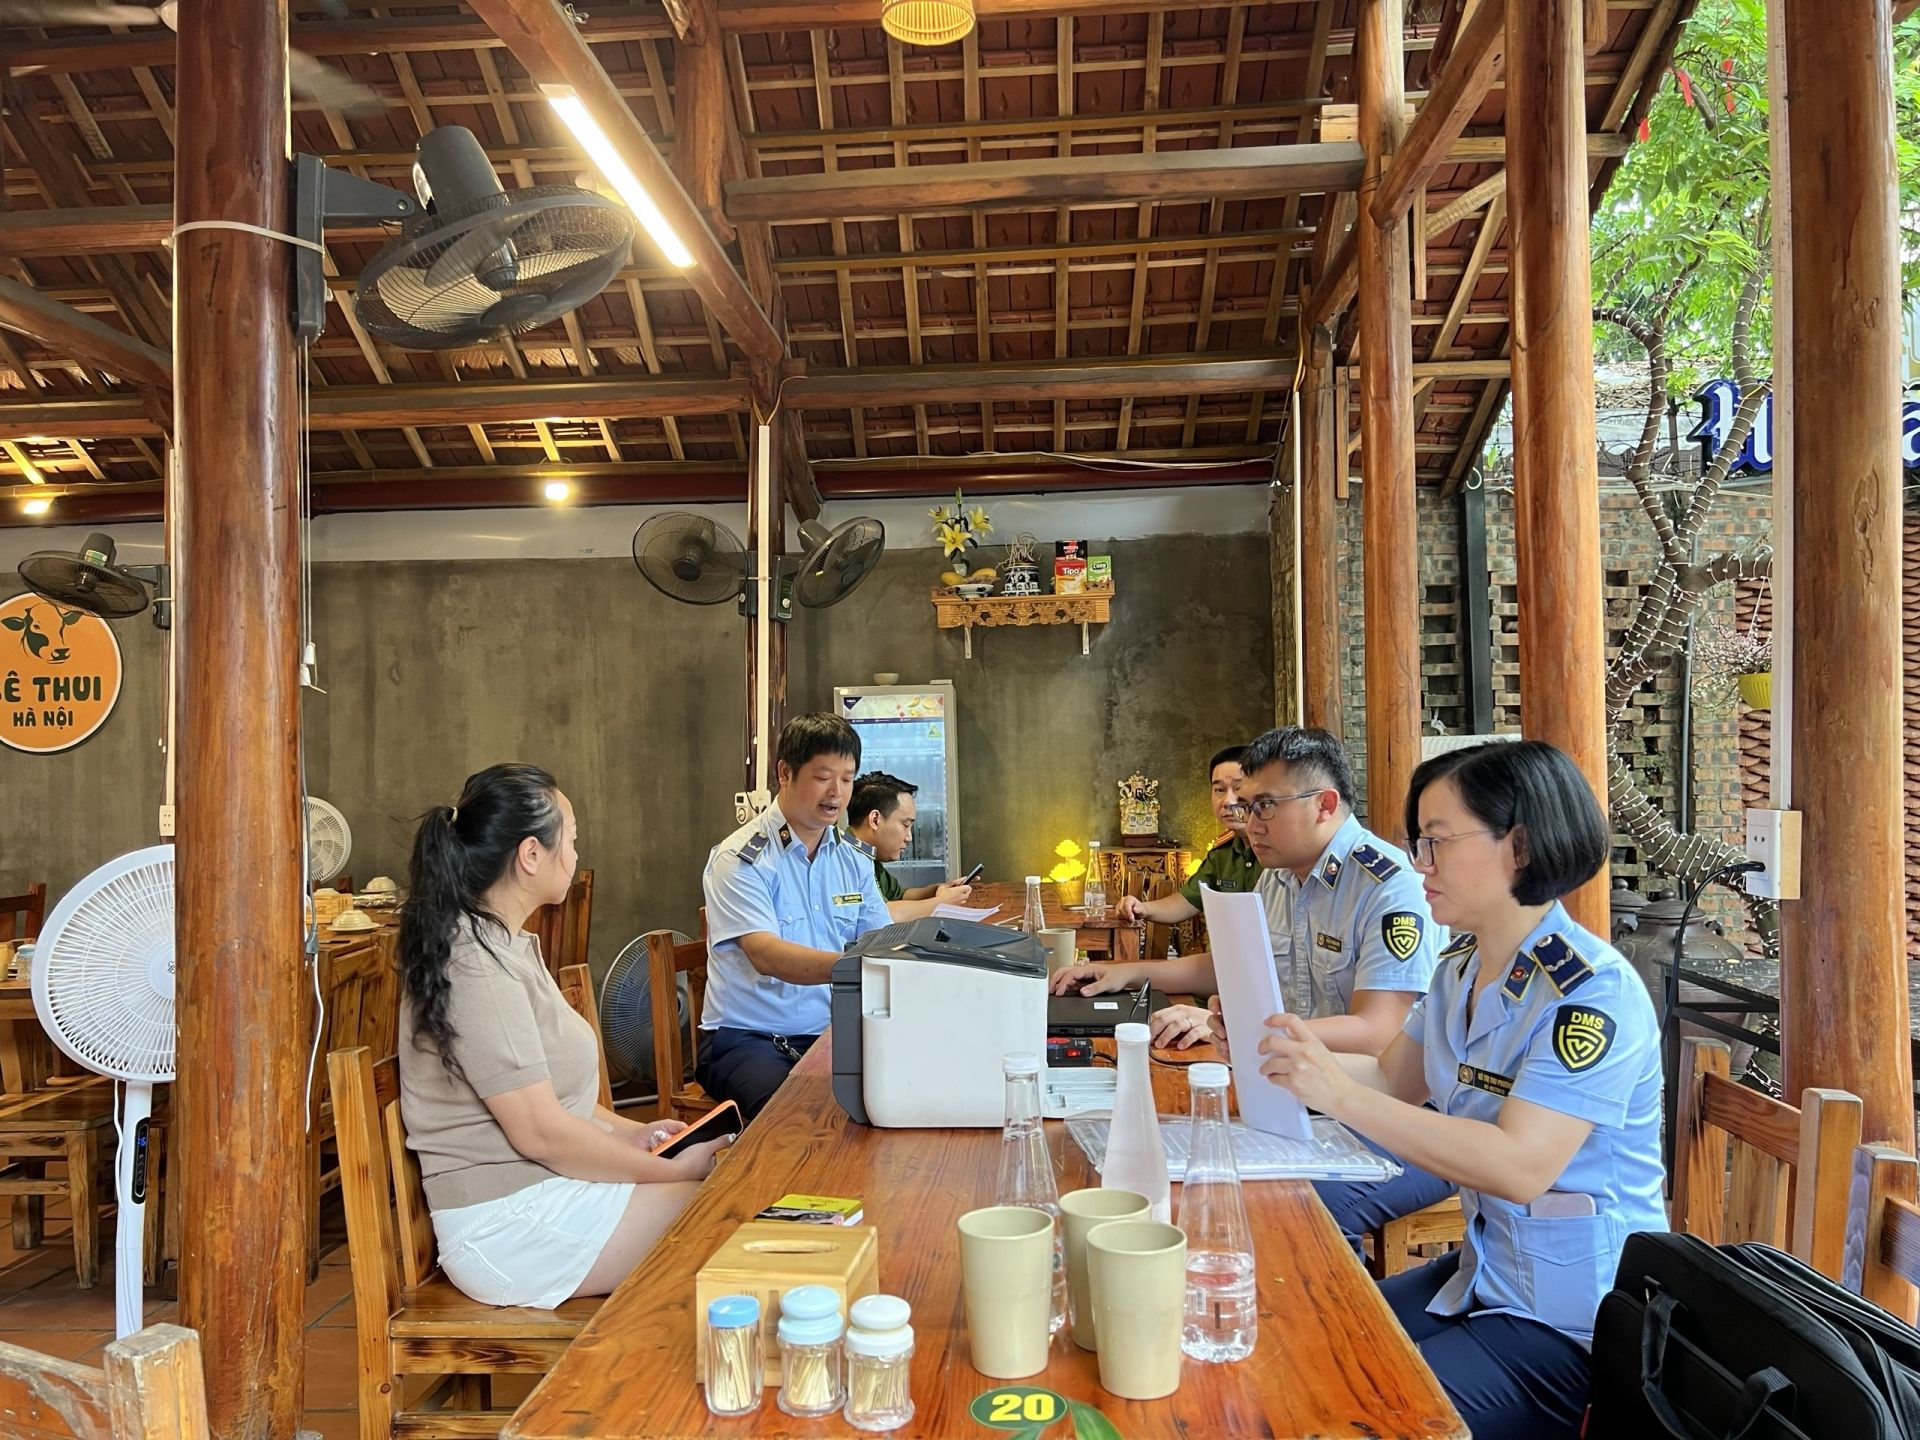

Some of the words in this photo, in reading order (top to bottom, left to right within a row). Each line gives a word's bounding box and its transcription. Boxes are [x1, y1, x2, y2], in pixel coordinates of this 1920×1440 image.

[1062, 567, 1080, 576] Tipo
[0, 670, 21, 702] Ê
[33, 677, 101, 702] THUI
[13, 707, 36, 727] HÀ
[44, 706, 73, 729] NỘI
[1393, 916, 1416, 927] DMS
[1571, 1011, 1605, 1030] DMS
[989, 1393, 1055, 1421] 20
